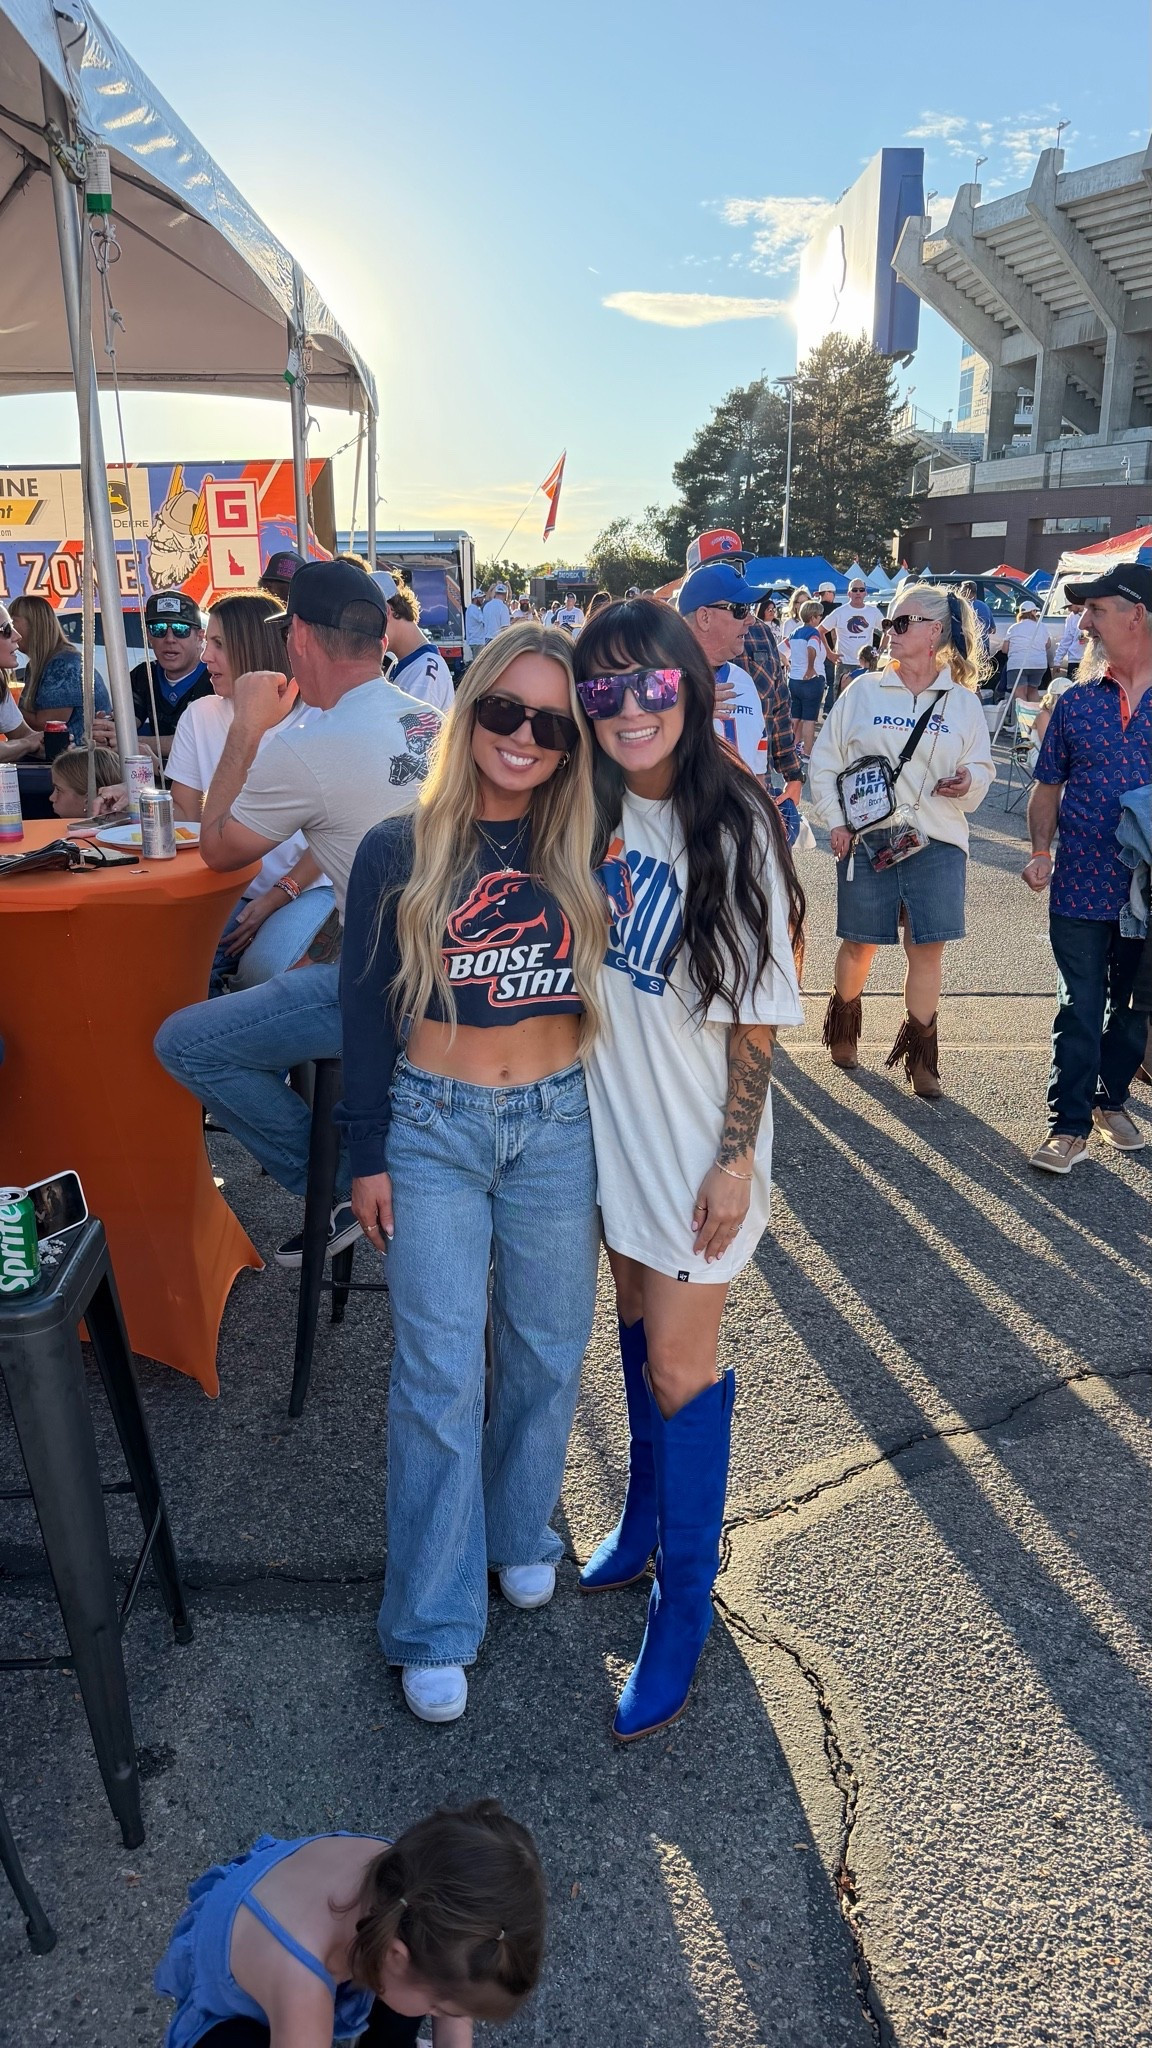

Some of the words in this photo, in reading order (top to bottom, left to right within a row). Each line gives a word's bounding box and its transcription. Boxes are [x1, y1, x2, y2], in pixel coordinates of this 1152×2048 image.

[873, 716, 949, 733] BRONOS
[449, 943, 551, 979] BOISE
[0, 1202, 34, 1292] Sprite
